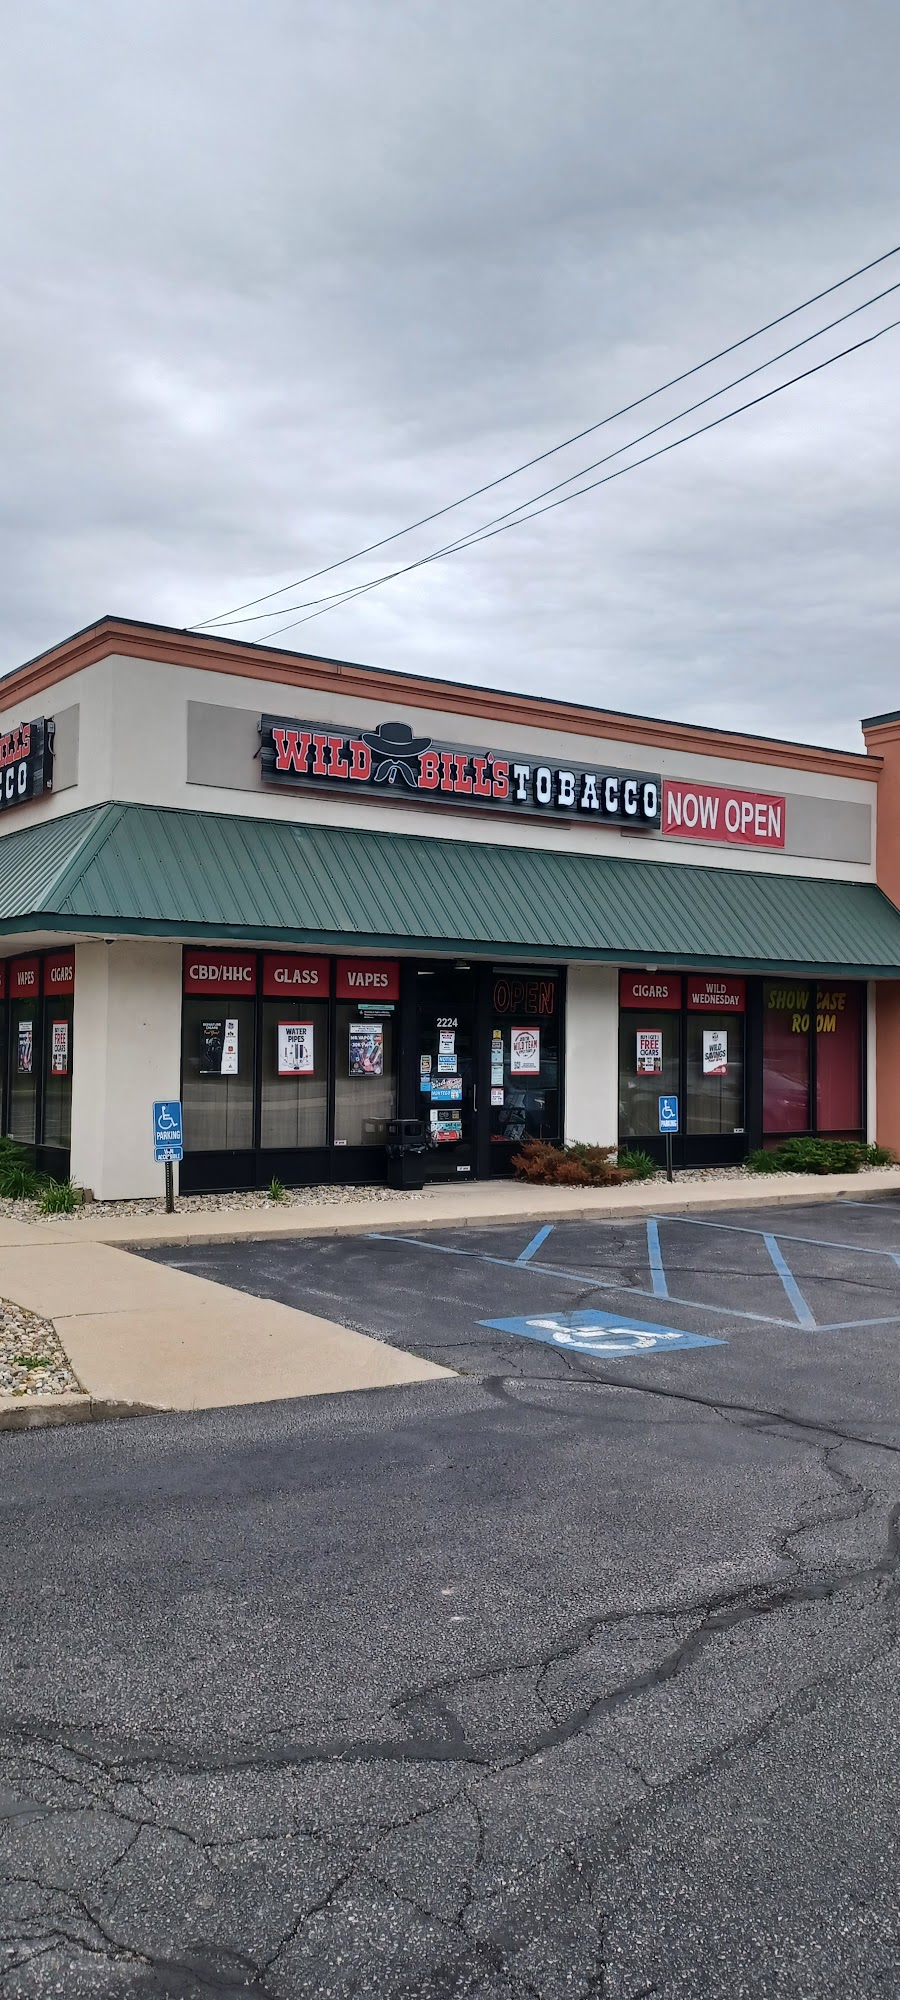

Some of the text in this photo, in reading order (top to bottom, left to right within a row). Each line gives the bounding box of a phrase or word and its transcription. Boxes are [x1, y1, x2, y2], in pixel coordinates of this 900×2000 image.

[273, 728, 658, 818] WILD BILL'S TOBACCO
[666, 790, 782, 838] NOW OPEN
[17, 971, 35, 986] VAPES
[50, 966, 73, 982] CIGARS
[189, 964, 252, 983] CBD/HHC
[273, 968, 319, 985] GLASS
[347, 971, 389, 988] VAPES
[632, 984, 669, 998] CIGARS
[705, 983, 727, 994] WILD
[493, 979, 555, 1014] OPEN
[691, 993, 740, 1006] WEDNESDAY
[436, 1017, 459, 1028] 2224
[285, 1027, 307, 1035] WATER
[287, 1035, 305, 1043] PIPES
[526, 1039, 538, 1050] TEAM
[640, 1039, 659, 1050] FREE
[708, 1043, 722, 1052] WILD
[704, 1049, 726, 1061] SAVINGS
[156, 1130, 181, 1141] PARKING
